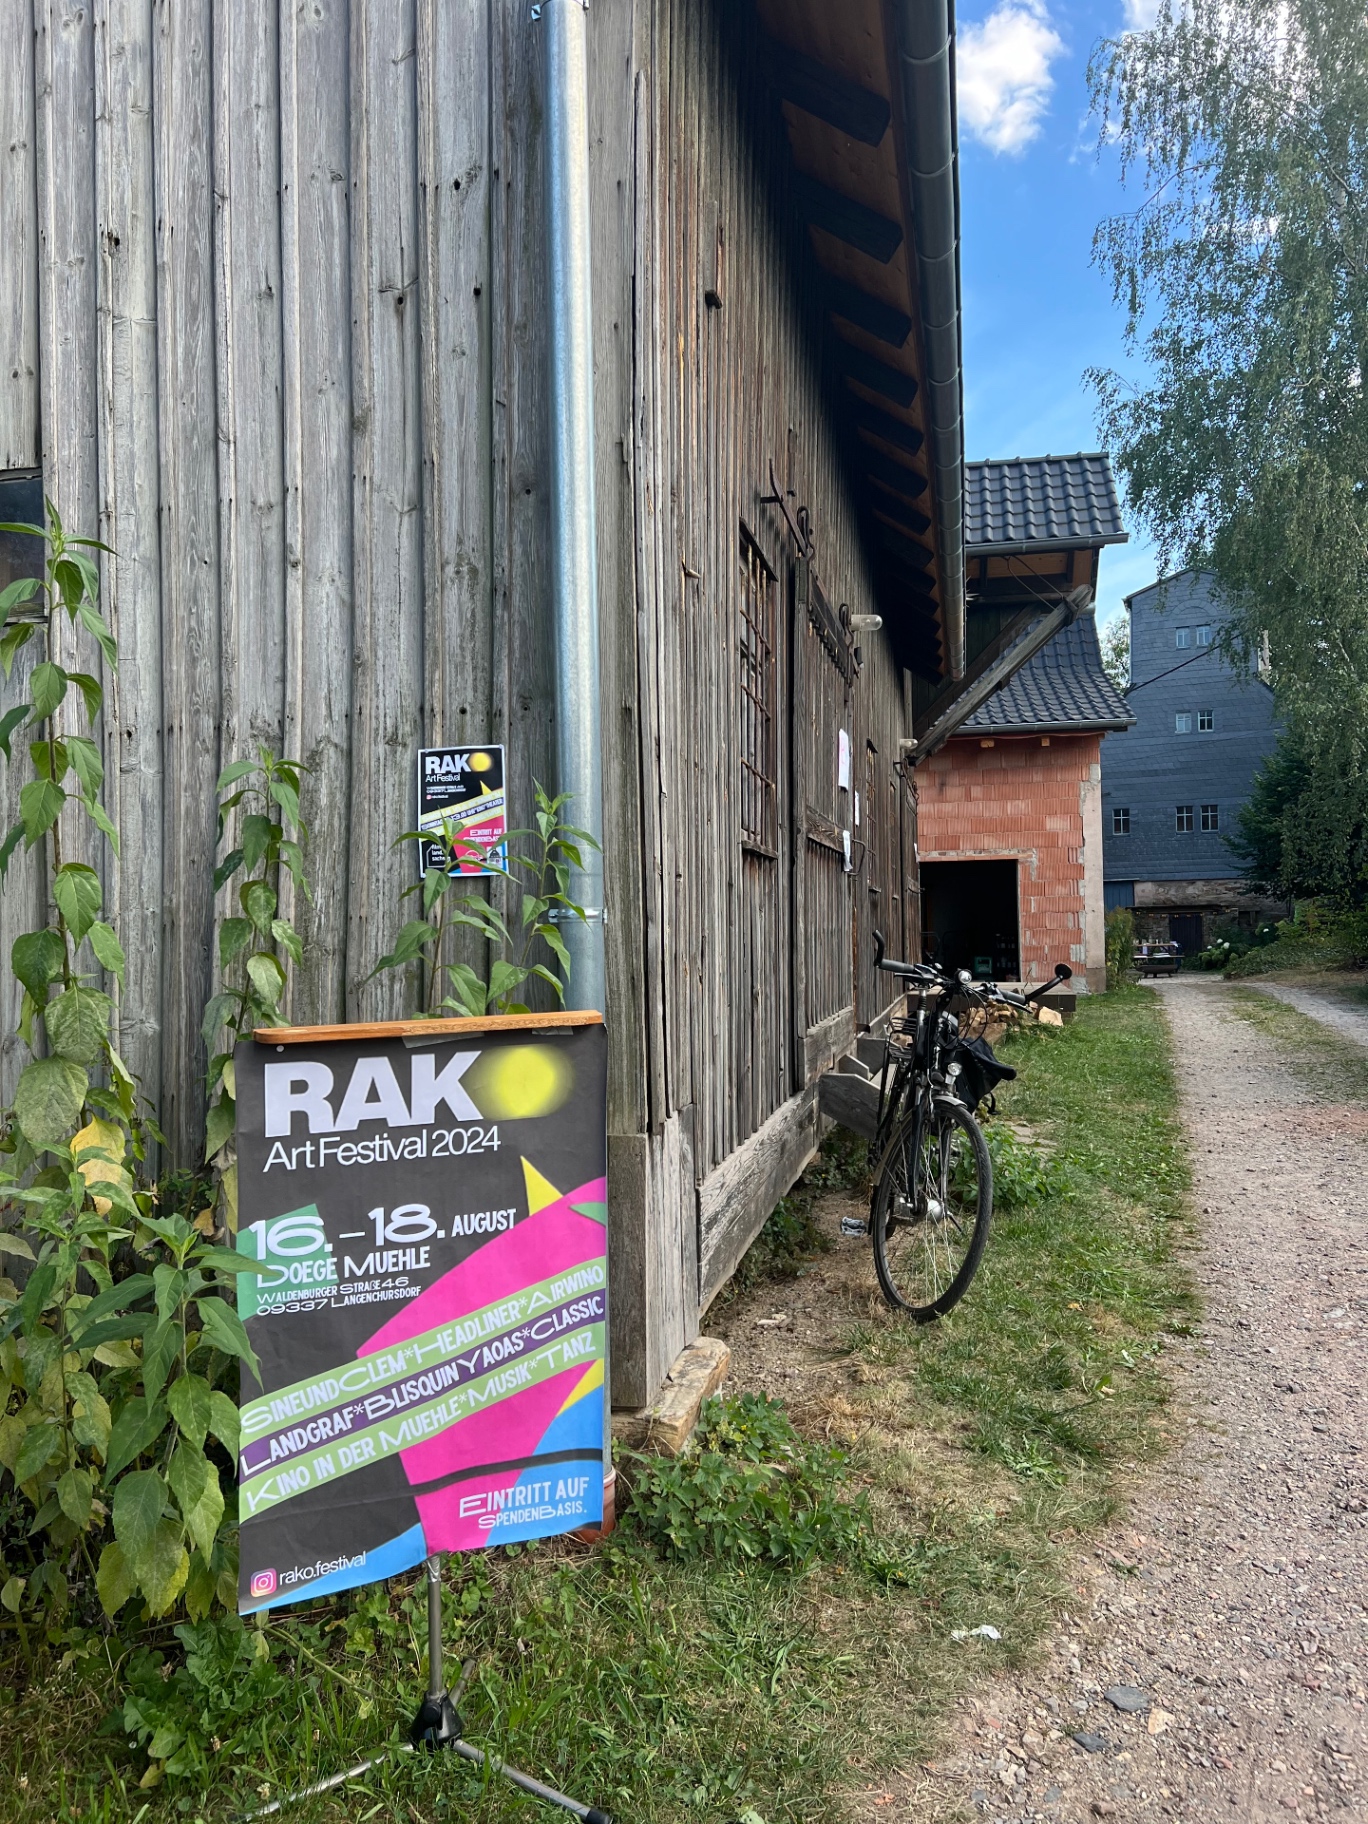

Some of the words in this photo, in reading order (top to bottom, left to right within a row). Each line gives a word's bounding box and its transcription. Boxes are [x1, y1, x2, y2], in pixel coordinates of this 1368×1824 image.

[319, 1129, 428, 1168] Festival
[432, 1126, 501, 1157] 2024
[451, 1208, 516, 1237] AUGUST
[344, 1246, 431, 1279] MUEHLE
[256, 1285, 338, 1304] WALDENBURGER
[382, 1276, 409, 1289] 46
[256, 1298, 329, 1316] 09337
[331, 1286, 422, 1308] LANGENCHURSDORF
[246, 1465, 311, 1513] KINO
[313, 1453, 337, 1480] IN
[337, 1436, 377, 1470] DER
[459, 1481, 552, 1518] EINTRITT
[555, 1477, 590, 1500] AUF
[279, 1551, 367, 1585] rako.festival
